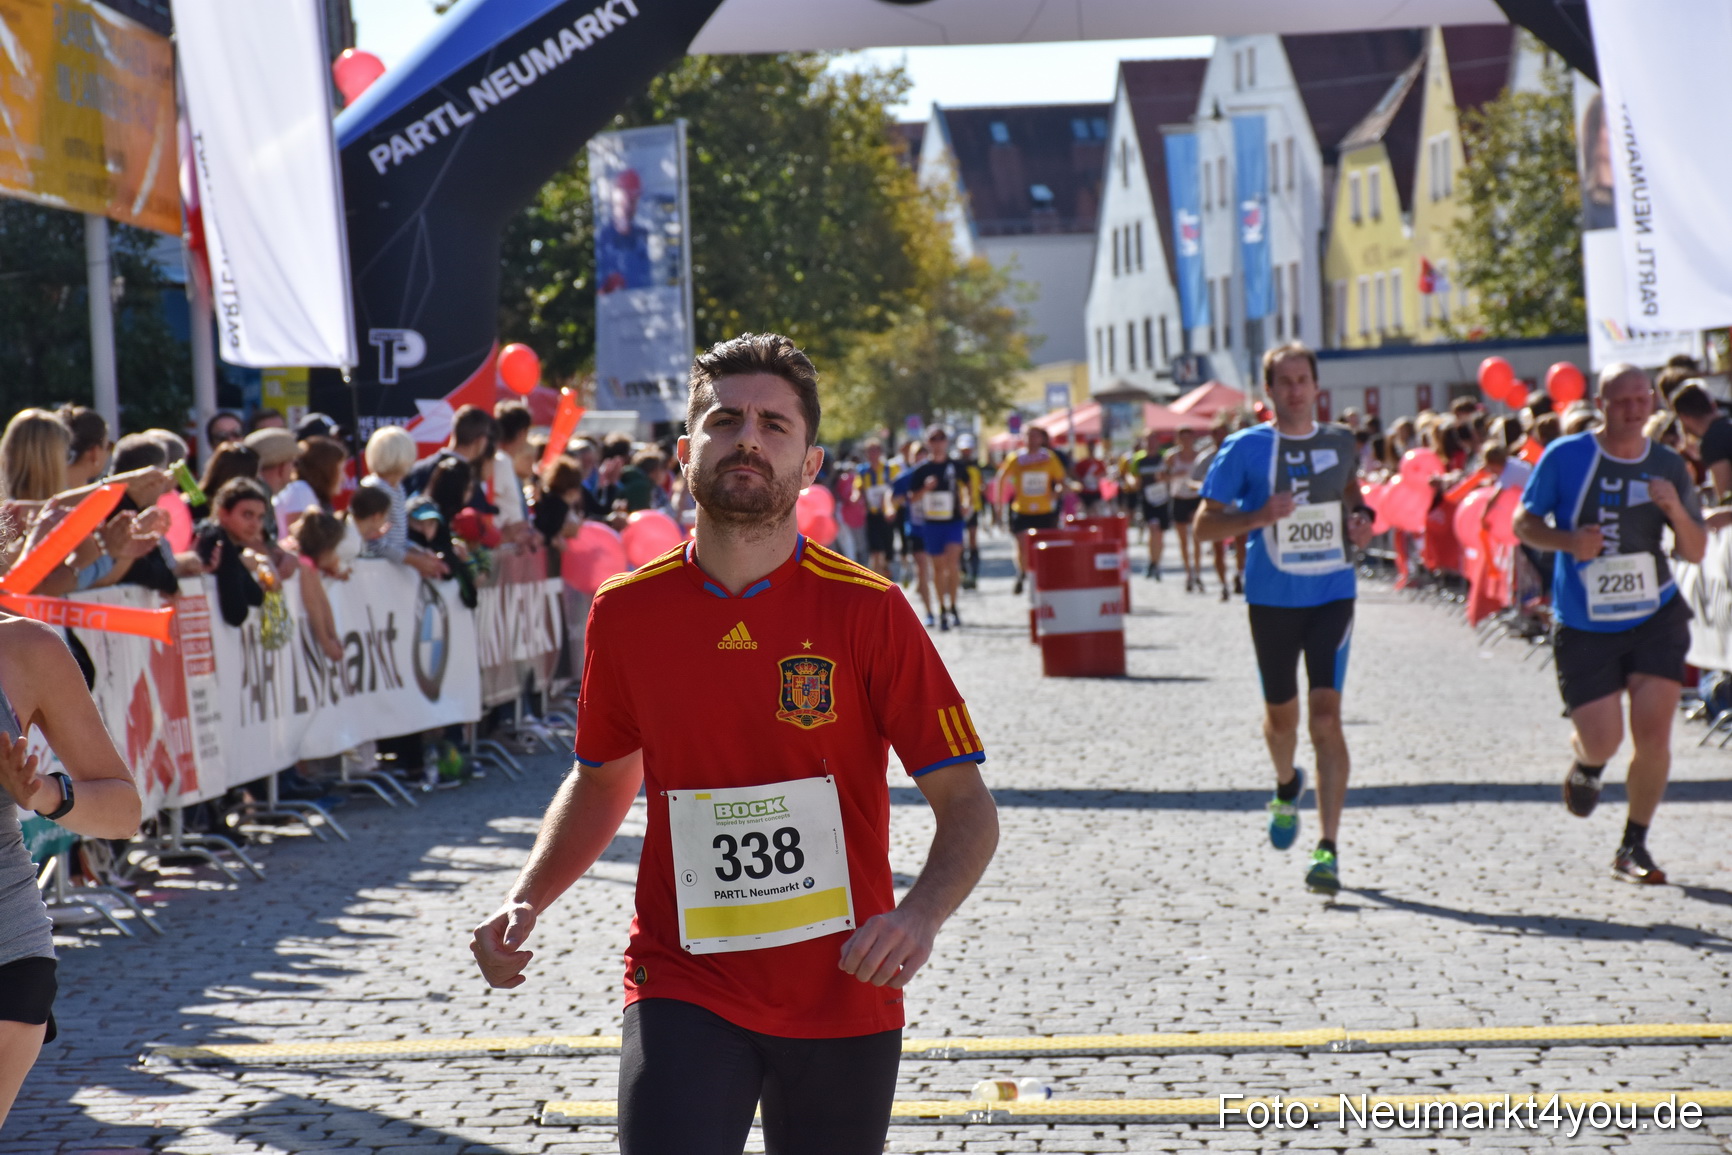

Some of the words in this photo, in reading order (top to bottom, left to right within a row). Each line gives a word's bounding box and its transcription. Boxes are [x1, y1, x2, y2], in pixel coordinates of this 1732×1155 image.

[368, 101, 476, 176] PARTL
[466, 0, 640, 114] NEUMARKT
[1288, 521, 1334, 543] 2009
[1598, 572, 1645, 595] 2281
[23, 600, 110, 631] DEHN
[717, 639, 758, 650] adidas
[713, 795, 789, 820] BOCK
[715, 819, 738, 827] inspired
[764, 812, 791, 824] concepts
[712, 826, 805, 882] 338
[686, 873, 692, 883] C
[714, 889, 748, 900] PARTL
[749, 881, 800, 898] Neumarkt
